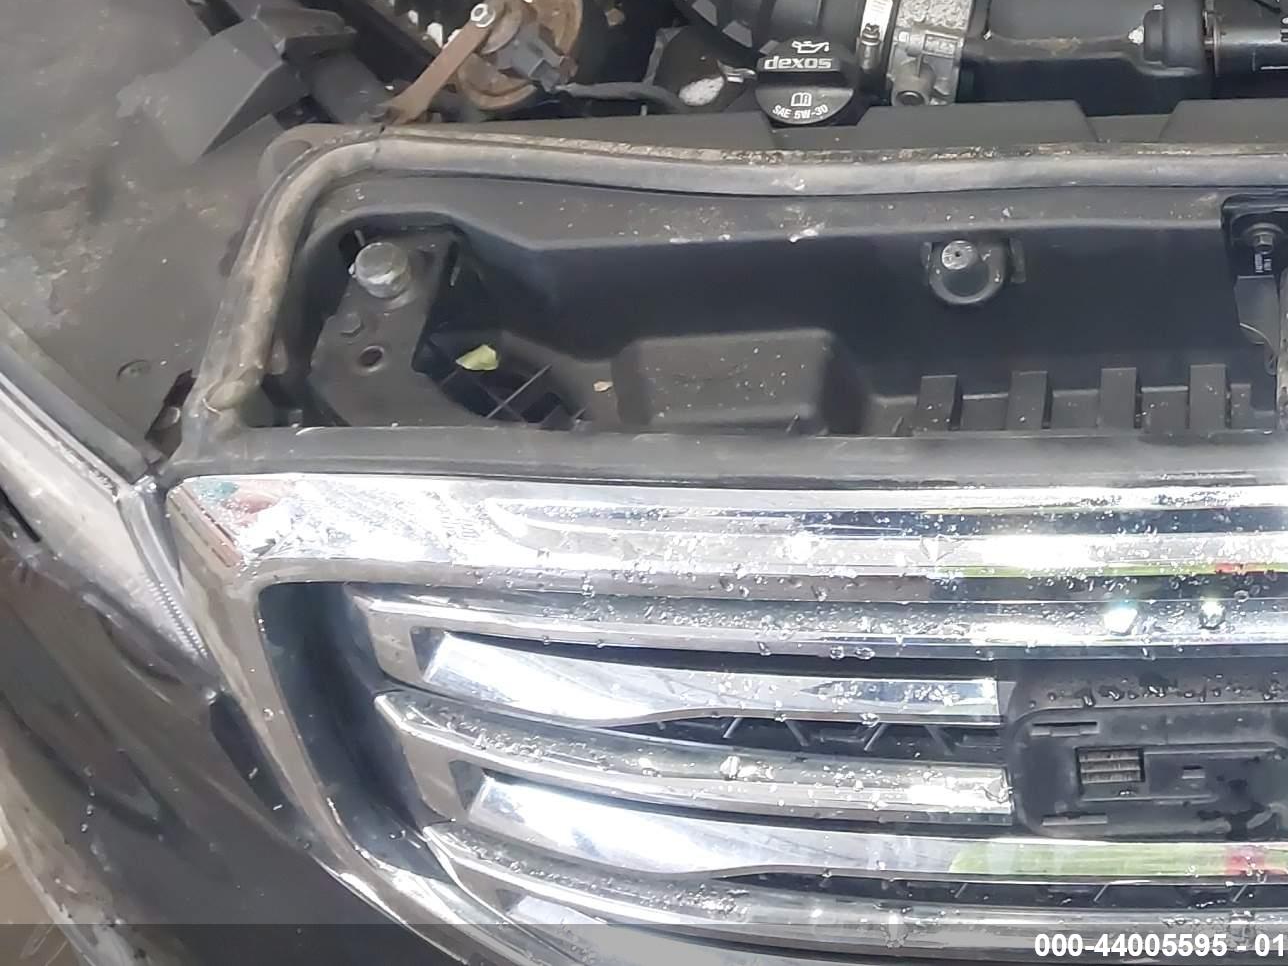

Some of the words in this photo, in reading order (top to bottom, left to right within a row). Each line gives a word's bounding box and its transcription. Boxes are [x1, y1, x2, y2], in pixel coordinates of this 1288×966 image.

[764, 56, 833, 69] dexos
[772, 104, 792, 118] SAE
[794, 104, 829, 119] 5W-30
